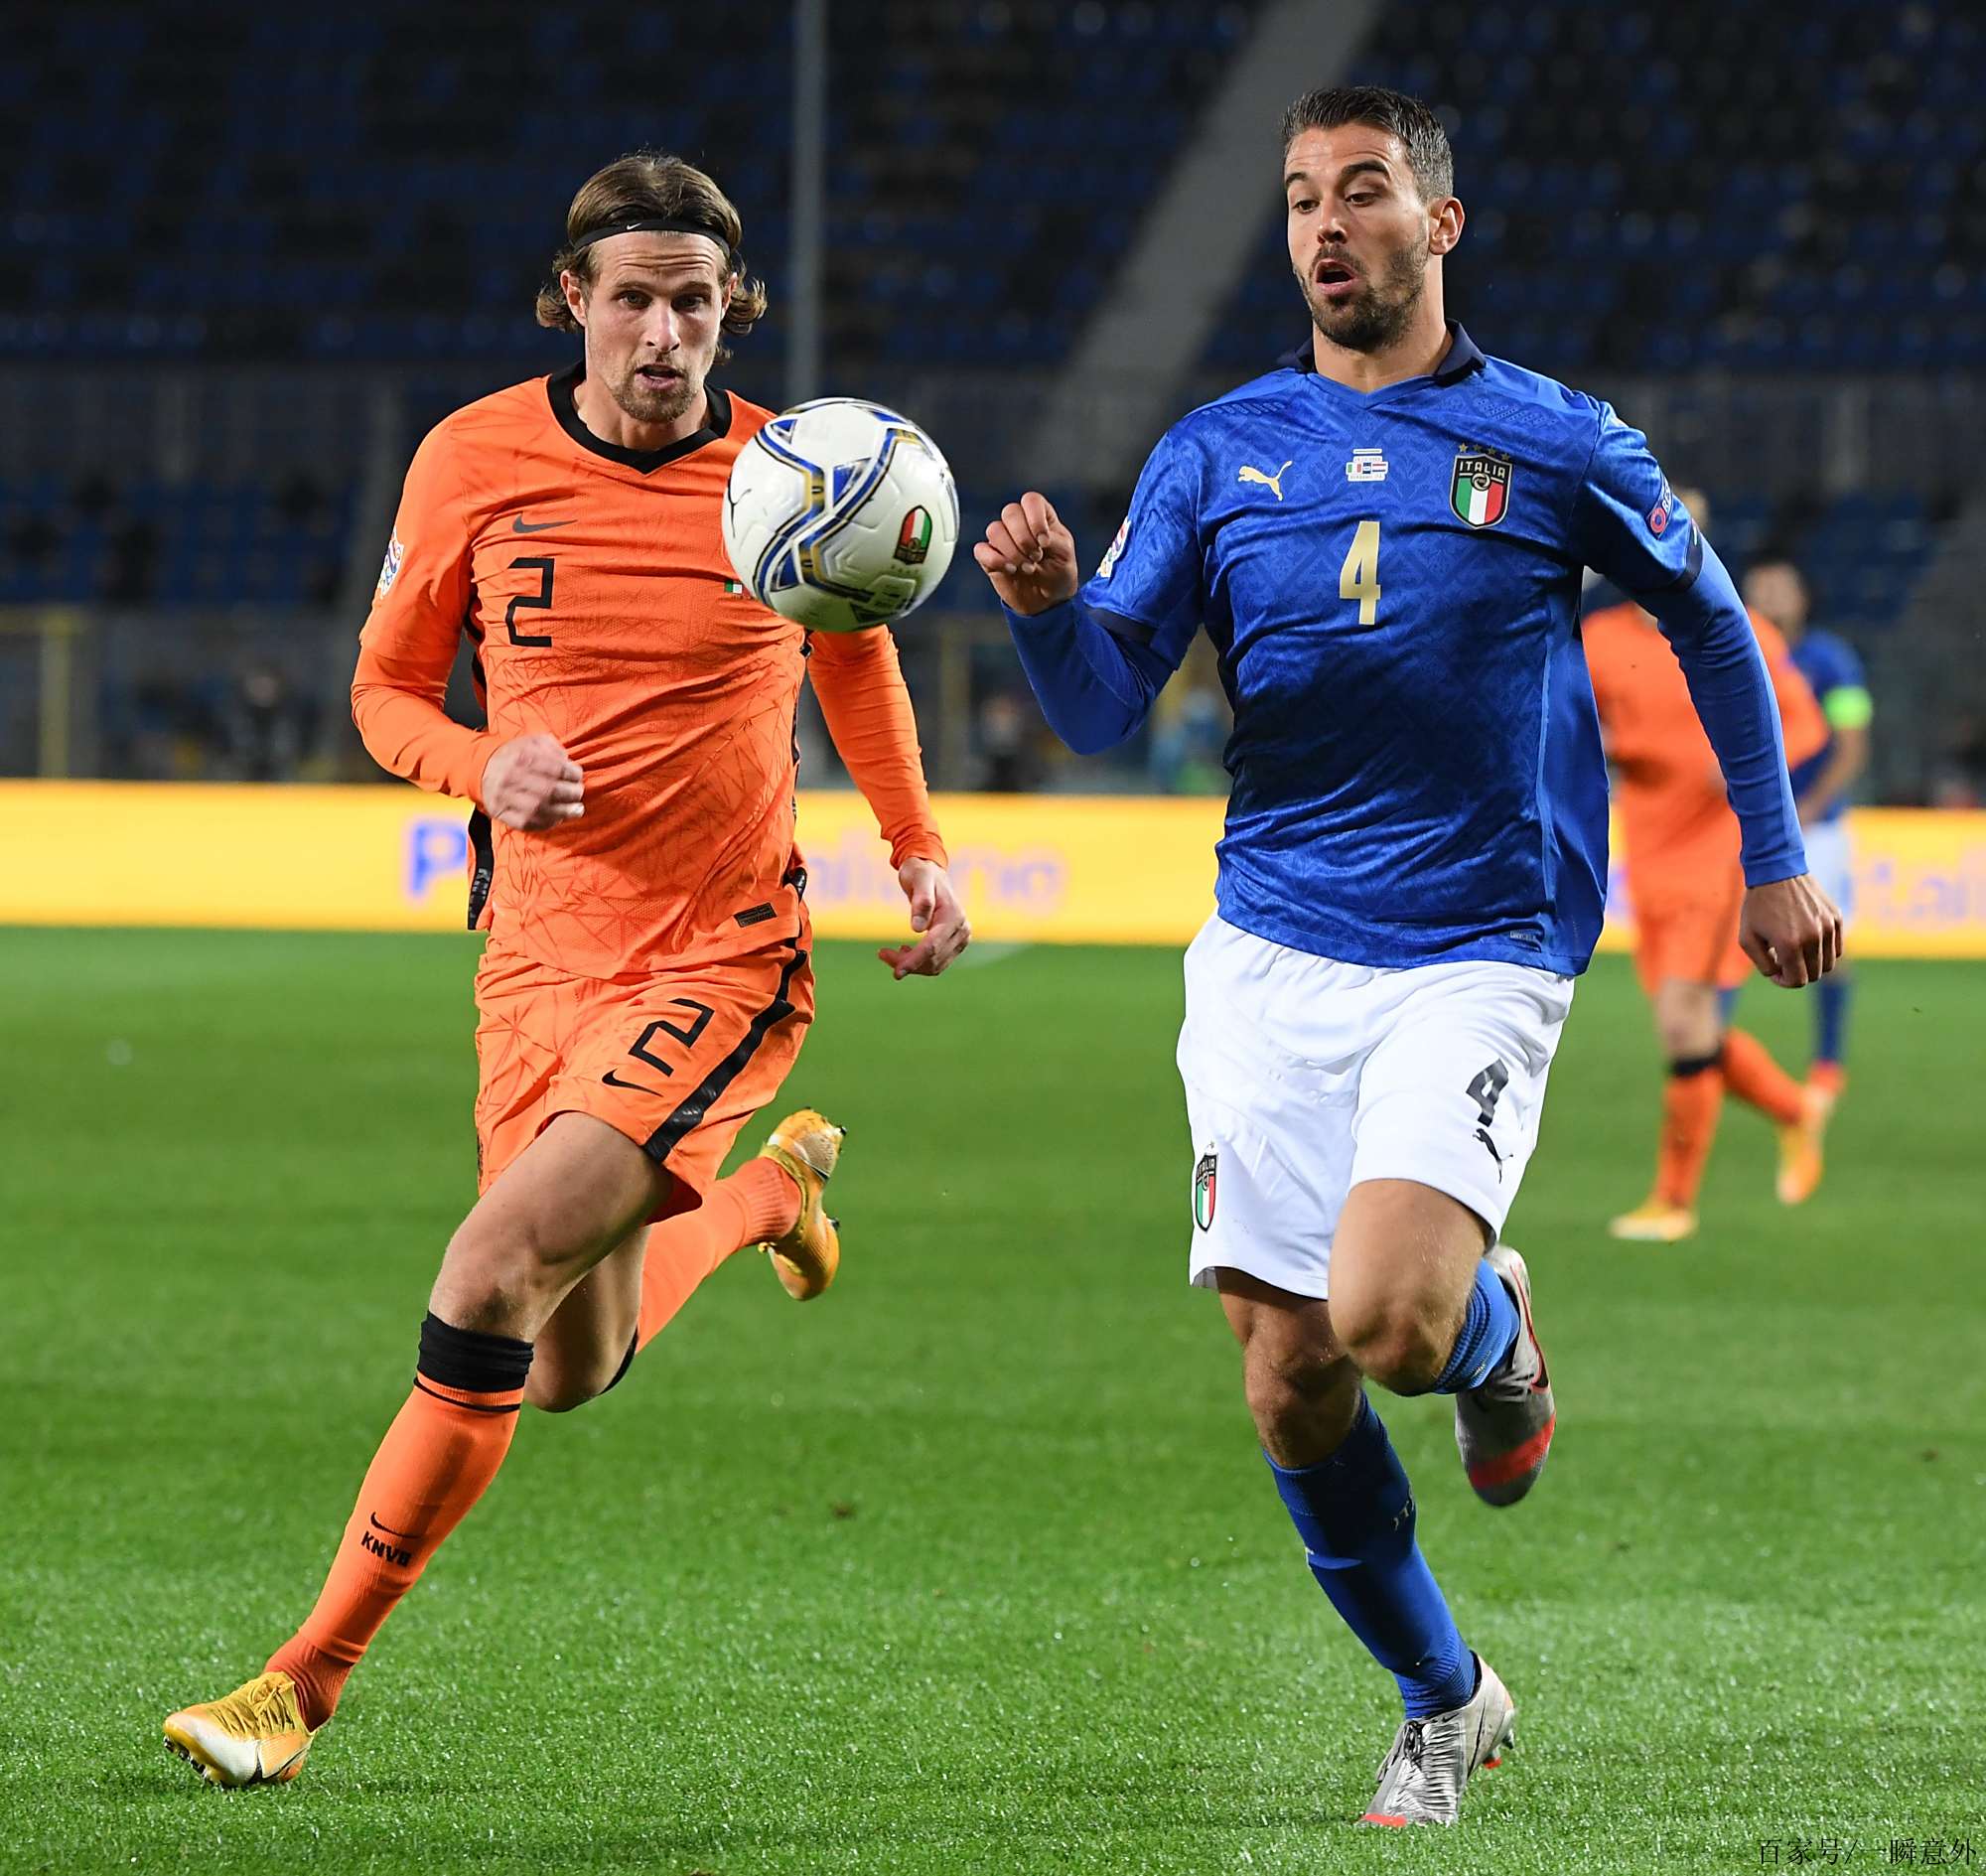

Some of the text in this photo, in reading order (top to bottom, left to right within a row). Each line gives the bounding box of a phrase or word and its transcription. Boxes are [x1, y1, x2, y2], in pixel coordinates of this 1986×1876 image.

[1459, 461, 1506, 479] ITALIA
[507, 558, 556, 649] 2
[1339, 520, 1381, 626] 4
[628, 997, 715, 1078] 2
[360, 1530, 412, 1568] KNVB
